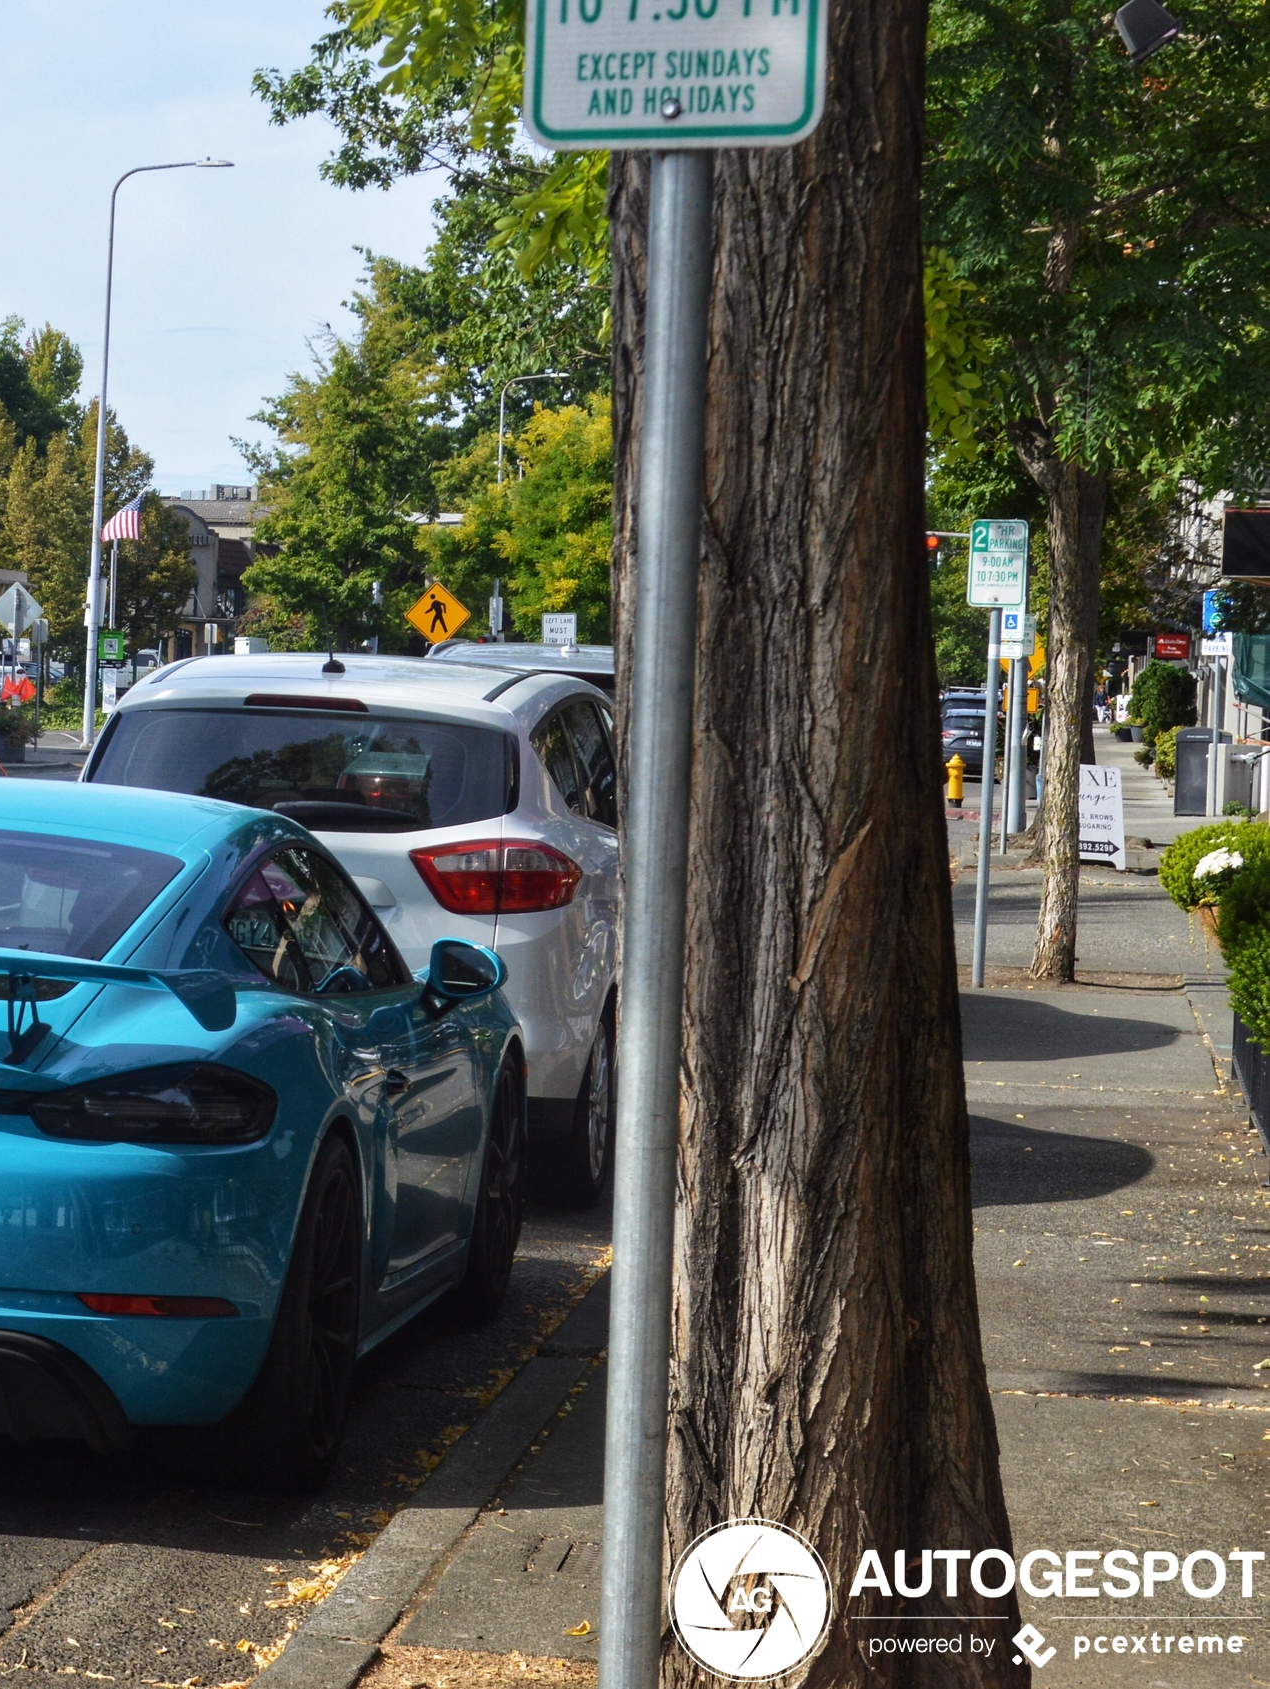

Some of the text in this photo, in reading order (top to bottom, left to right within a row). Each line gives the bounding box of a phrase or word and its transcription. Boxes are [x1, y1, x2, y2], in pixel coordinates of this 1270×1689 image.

[578, 47, 770, 82] EXCEPT SUNDAYS
[588, 88, 633, 116] AND
[1000, 525, 1015, 536] HR
[974, 526, 987, 548] 2
[990, 539, 1023, 550] PARKING
[982, 556, 1014, 568] 9:00 AM
[977, 571, 1018, 582] TO 7:30 PM
[1204, 645, 1230, 653] PARKING
[1079, 769, 1117, 788] XE
[1079, 793, 1116, 806] unge
[1090, 814, 1116, 822] BROWS,
